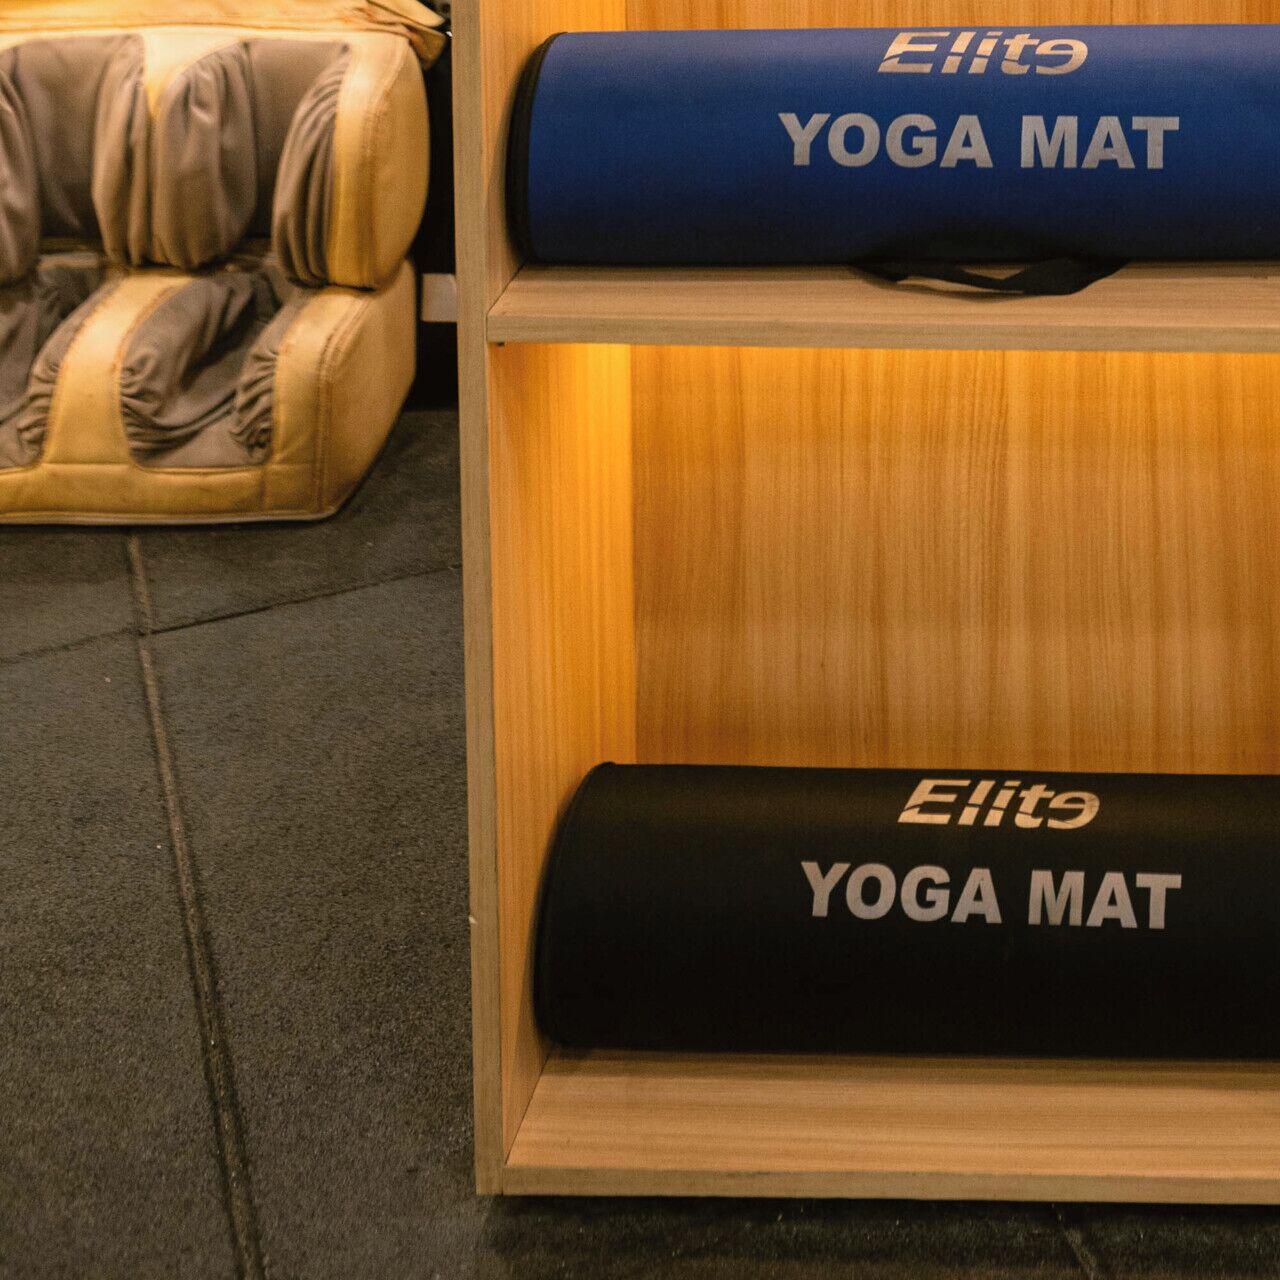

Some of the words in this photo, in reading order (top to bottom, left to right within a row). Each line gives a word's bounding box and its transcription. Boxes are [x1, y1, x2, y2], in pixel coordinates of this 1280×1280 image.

[878, 31, 1088, 75] Elite
[778, 113, 993, 169] YOGA
[1020, 115, 1180, 169] MAT
[897, 779, 1100, 829] Elite
[801, 861, 1002, 924] YOGA
[1028, 869, 1182, 929] MAT
